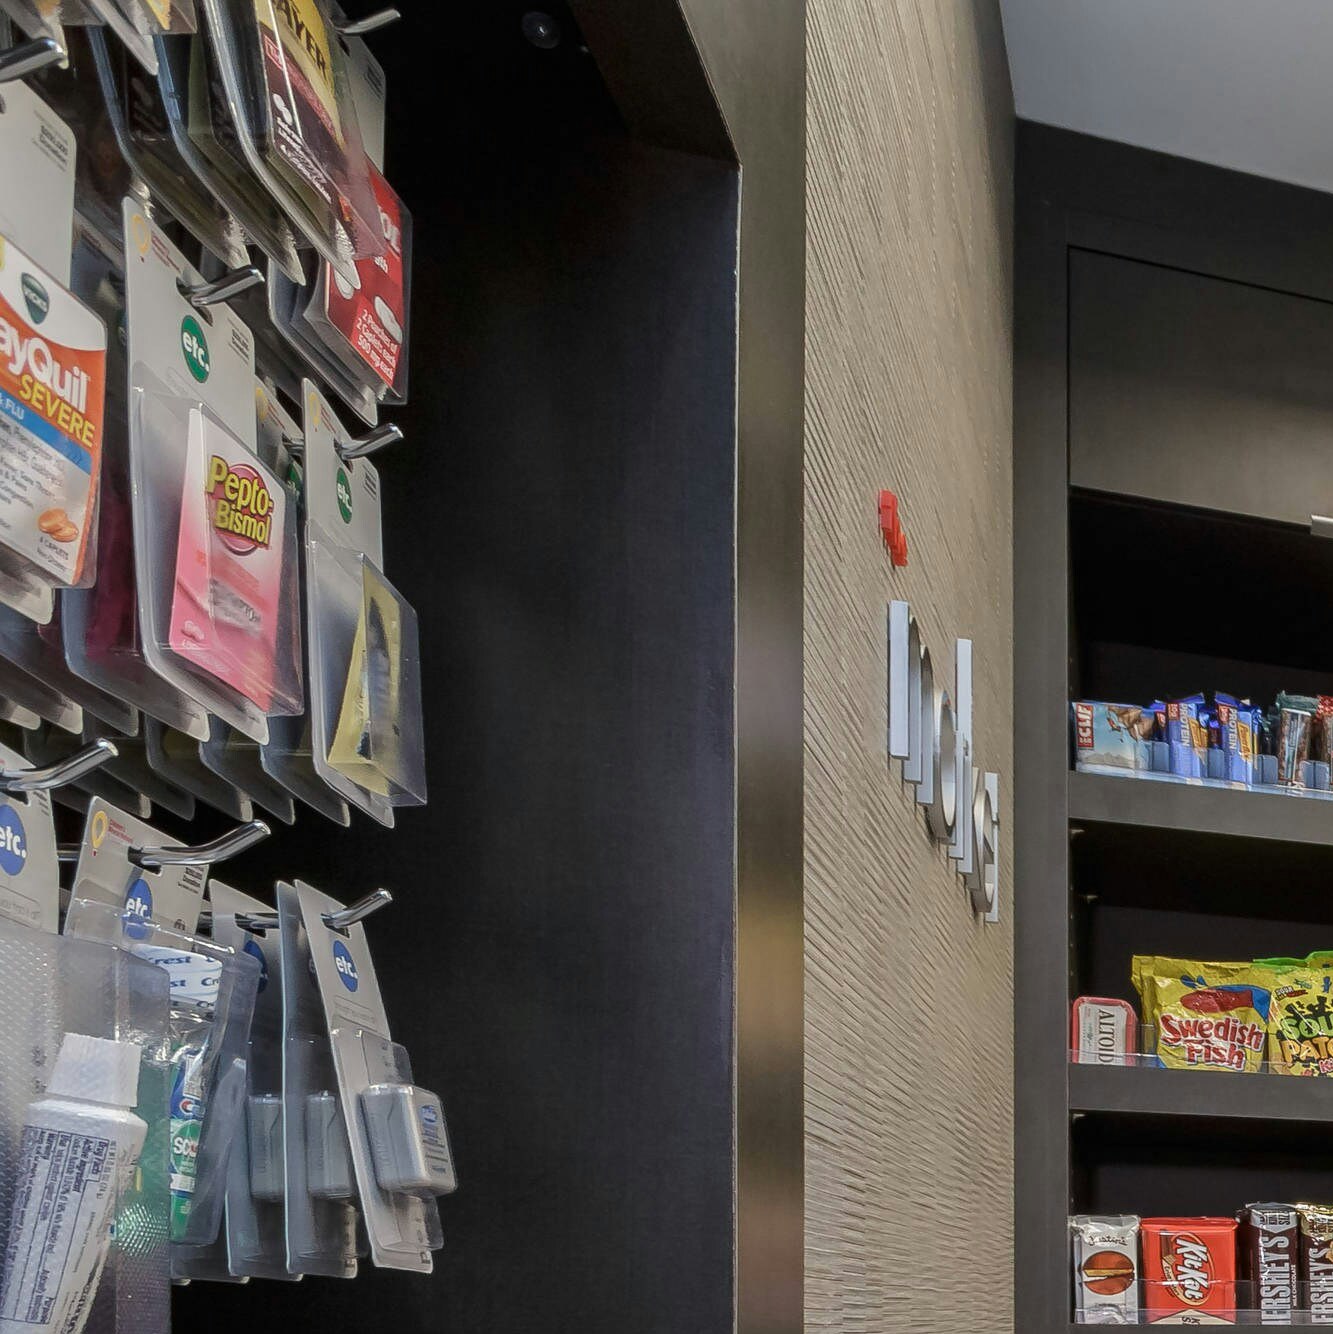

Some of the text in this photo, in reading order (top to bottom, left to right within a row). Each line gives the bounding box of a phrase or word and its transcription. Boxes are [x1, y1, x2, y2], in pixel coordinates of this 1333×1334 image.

[182, 331, 210, 373] etc.
[19, 374, 95, 449] SEVERE
[215, 499, 273, 546] Bismol
[1180, 703, 1190, 748] PROTEIN
[1228, 708, 1238, 750] PROTEIN
[149, 955, 191, 966] rest
[334, 953, 359, 980] etc.
[1160, 1014, 1265, 1051] Swedish
[1186, 1040, 1246, 1071] Fish
